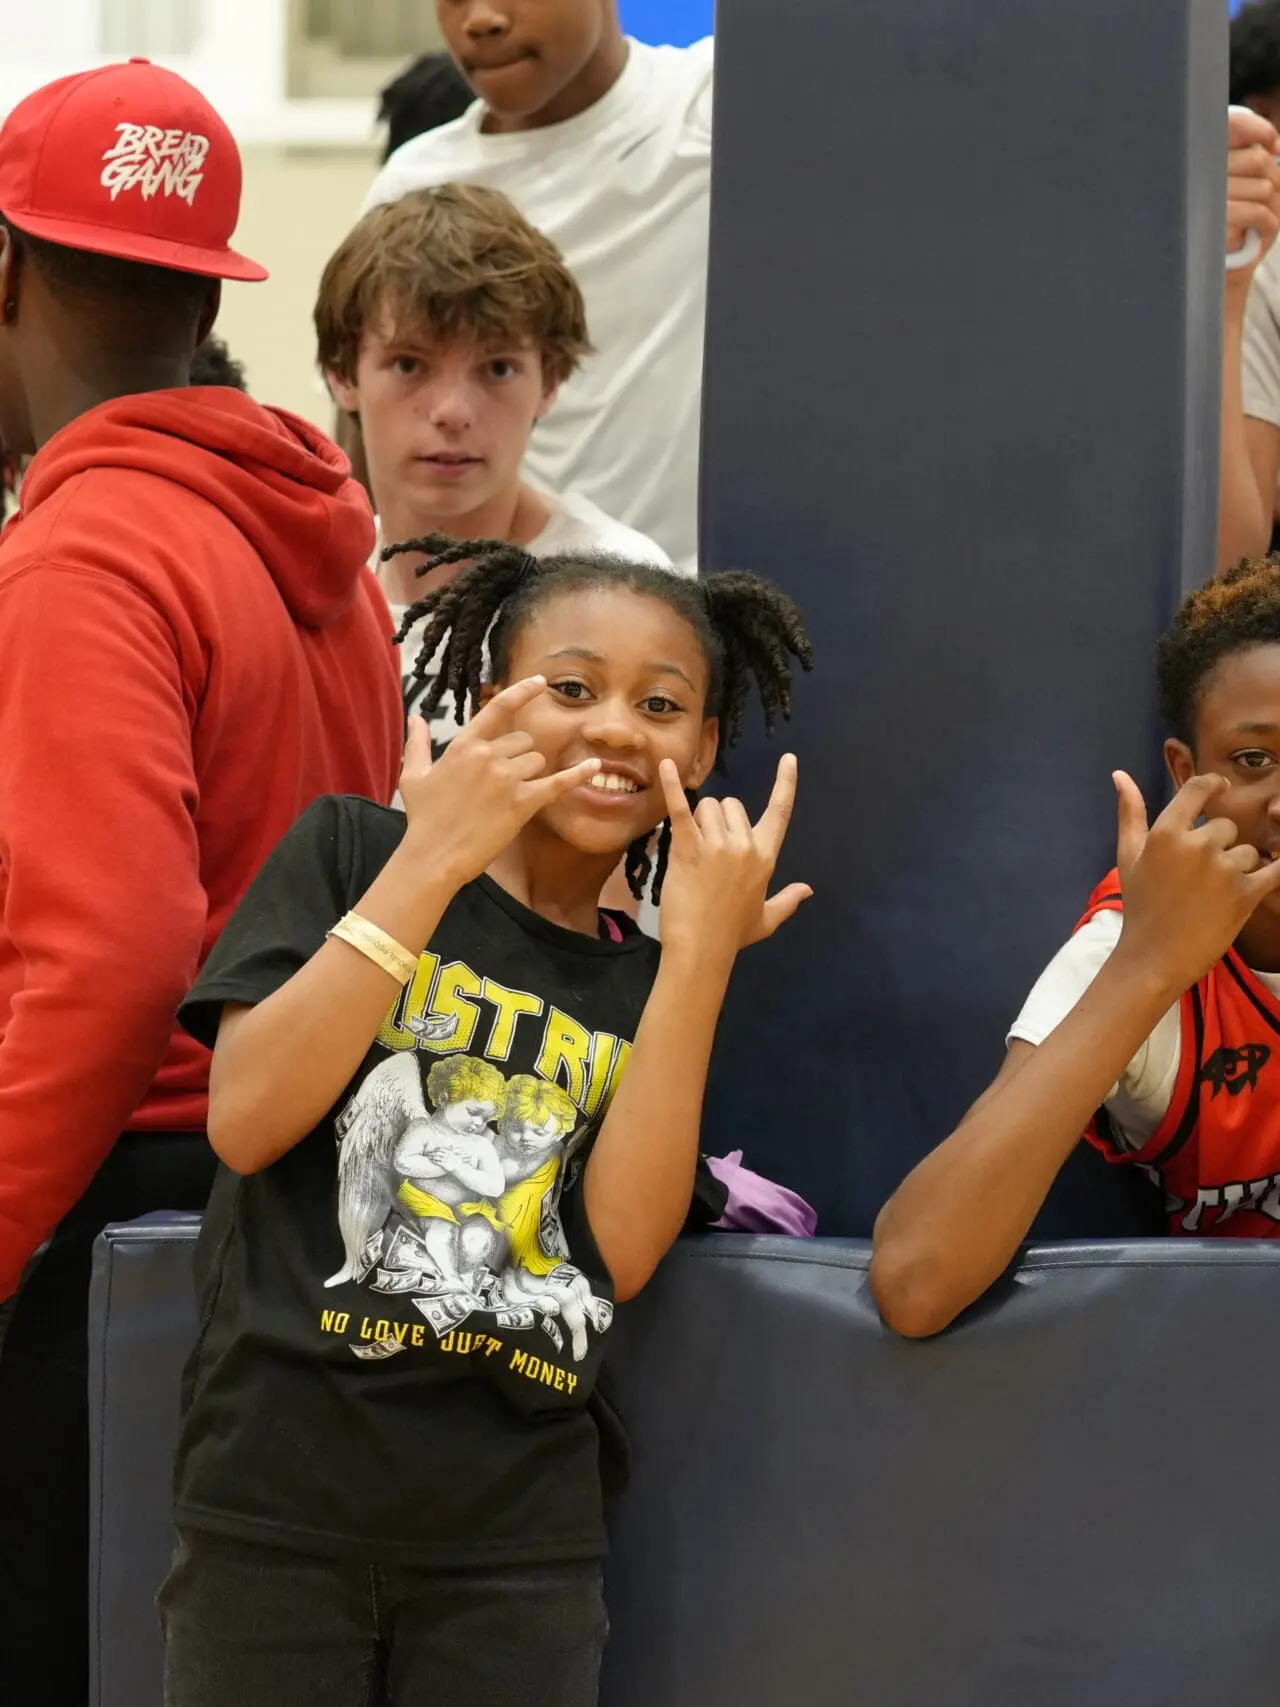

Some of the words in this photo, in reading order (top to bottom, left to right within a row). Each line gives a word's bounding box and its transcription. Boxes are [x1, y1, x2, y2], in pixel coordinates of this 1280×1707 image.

[101, 122, 210, 166] BREAD
[101, 153, 204, 208] GANG
[374, 950, 544, 1062] UST
[534, 1005, 633, 1118] RI
[320, 1309, 350, 1334] NO
[359, 1316, 426, 1348] LOVE
[440, 1331, 503, 1358] JUST
[508, 1348, 579, 1395] MONEY
